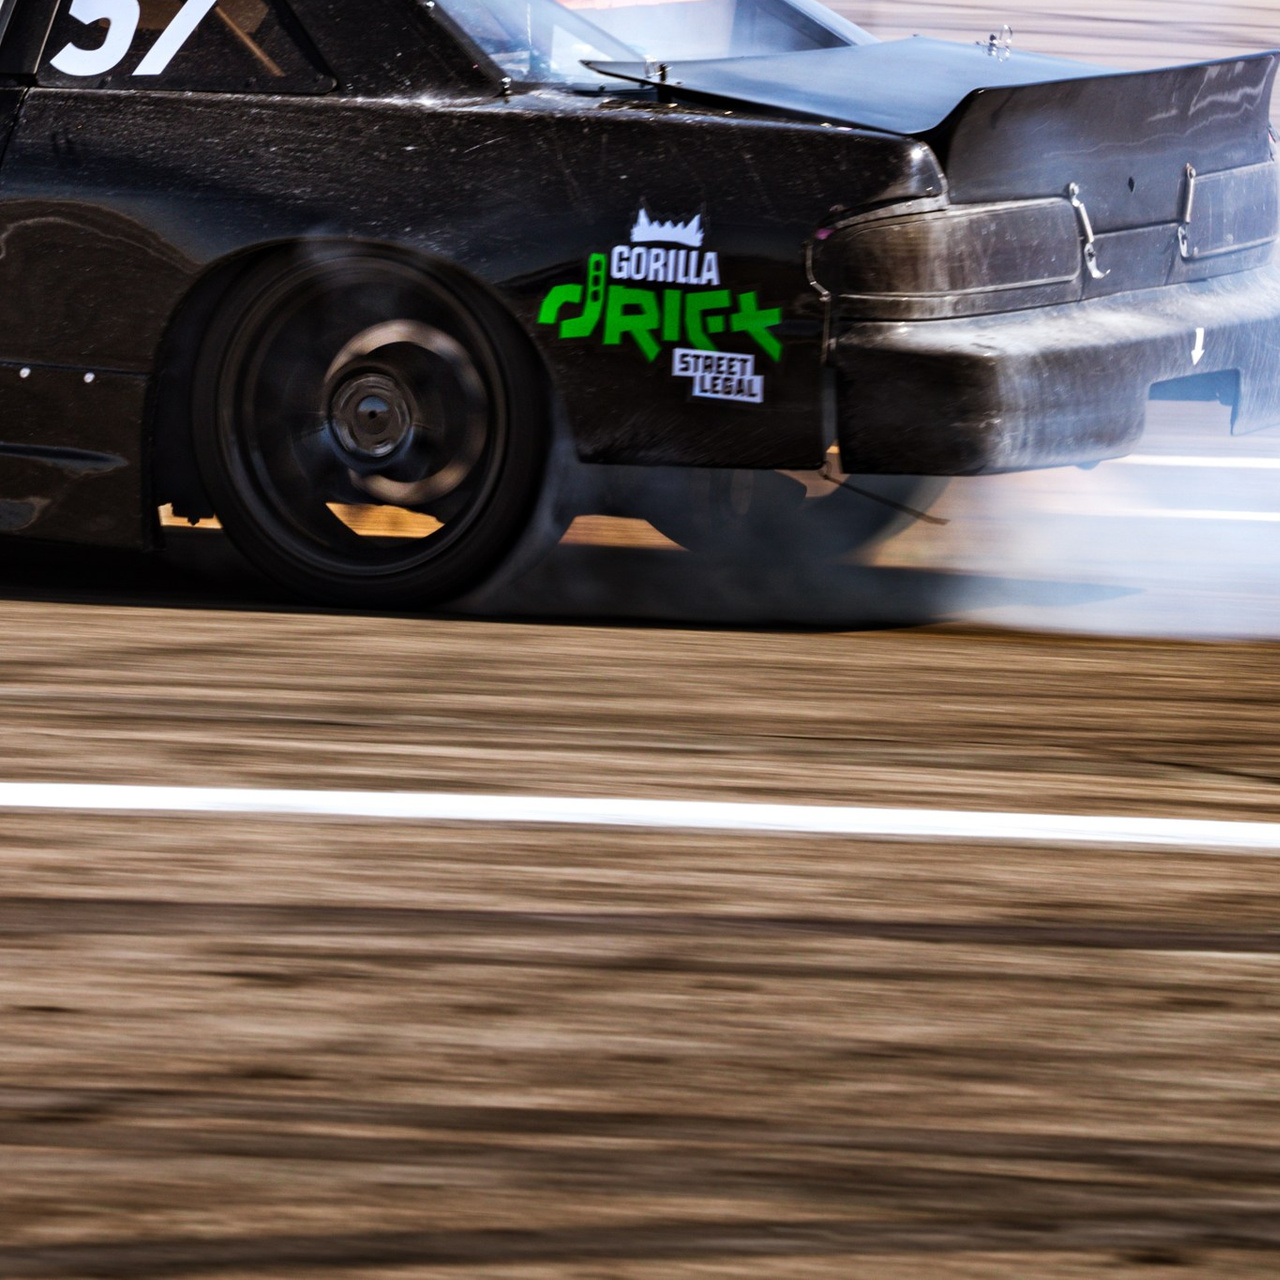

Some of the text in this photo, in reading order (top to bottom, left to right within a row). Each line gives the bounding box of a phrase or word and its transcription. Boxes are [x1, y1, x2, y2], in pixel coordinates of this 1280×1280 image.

[610, 245, 721, 286] GORILLA
[678, 353, 751, 376] STREET
[699, 374, 760, 398] LEGAL
